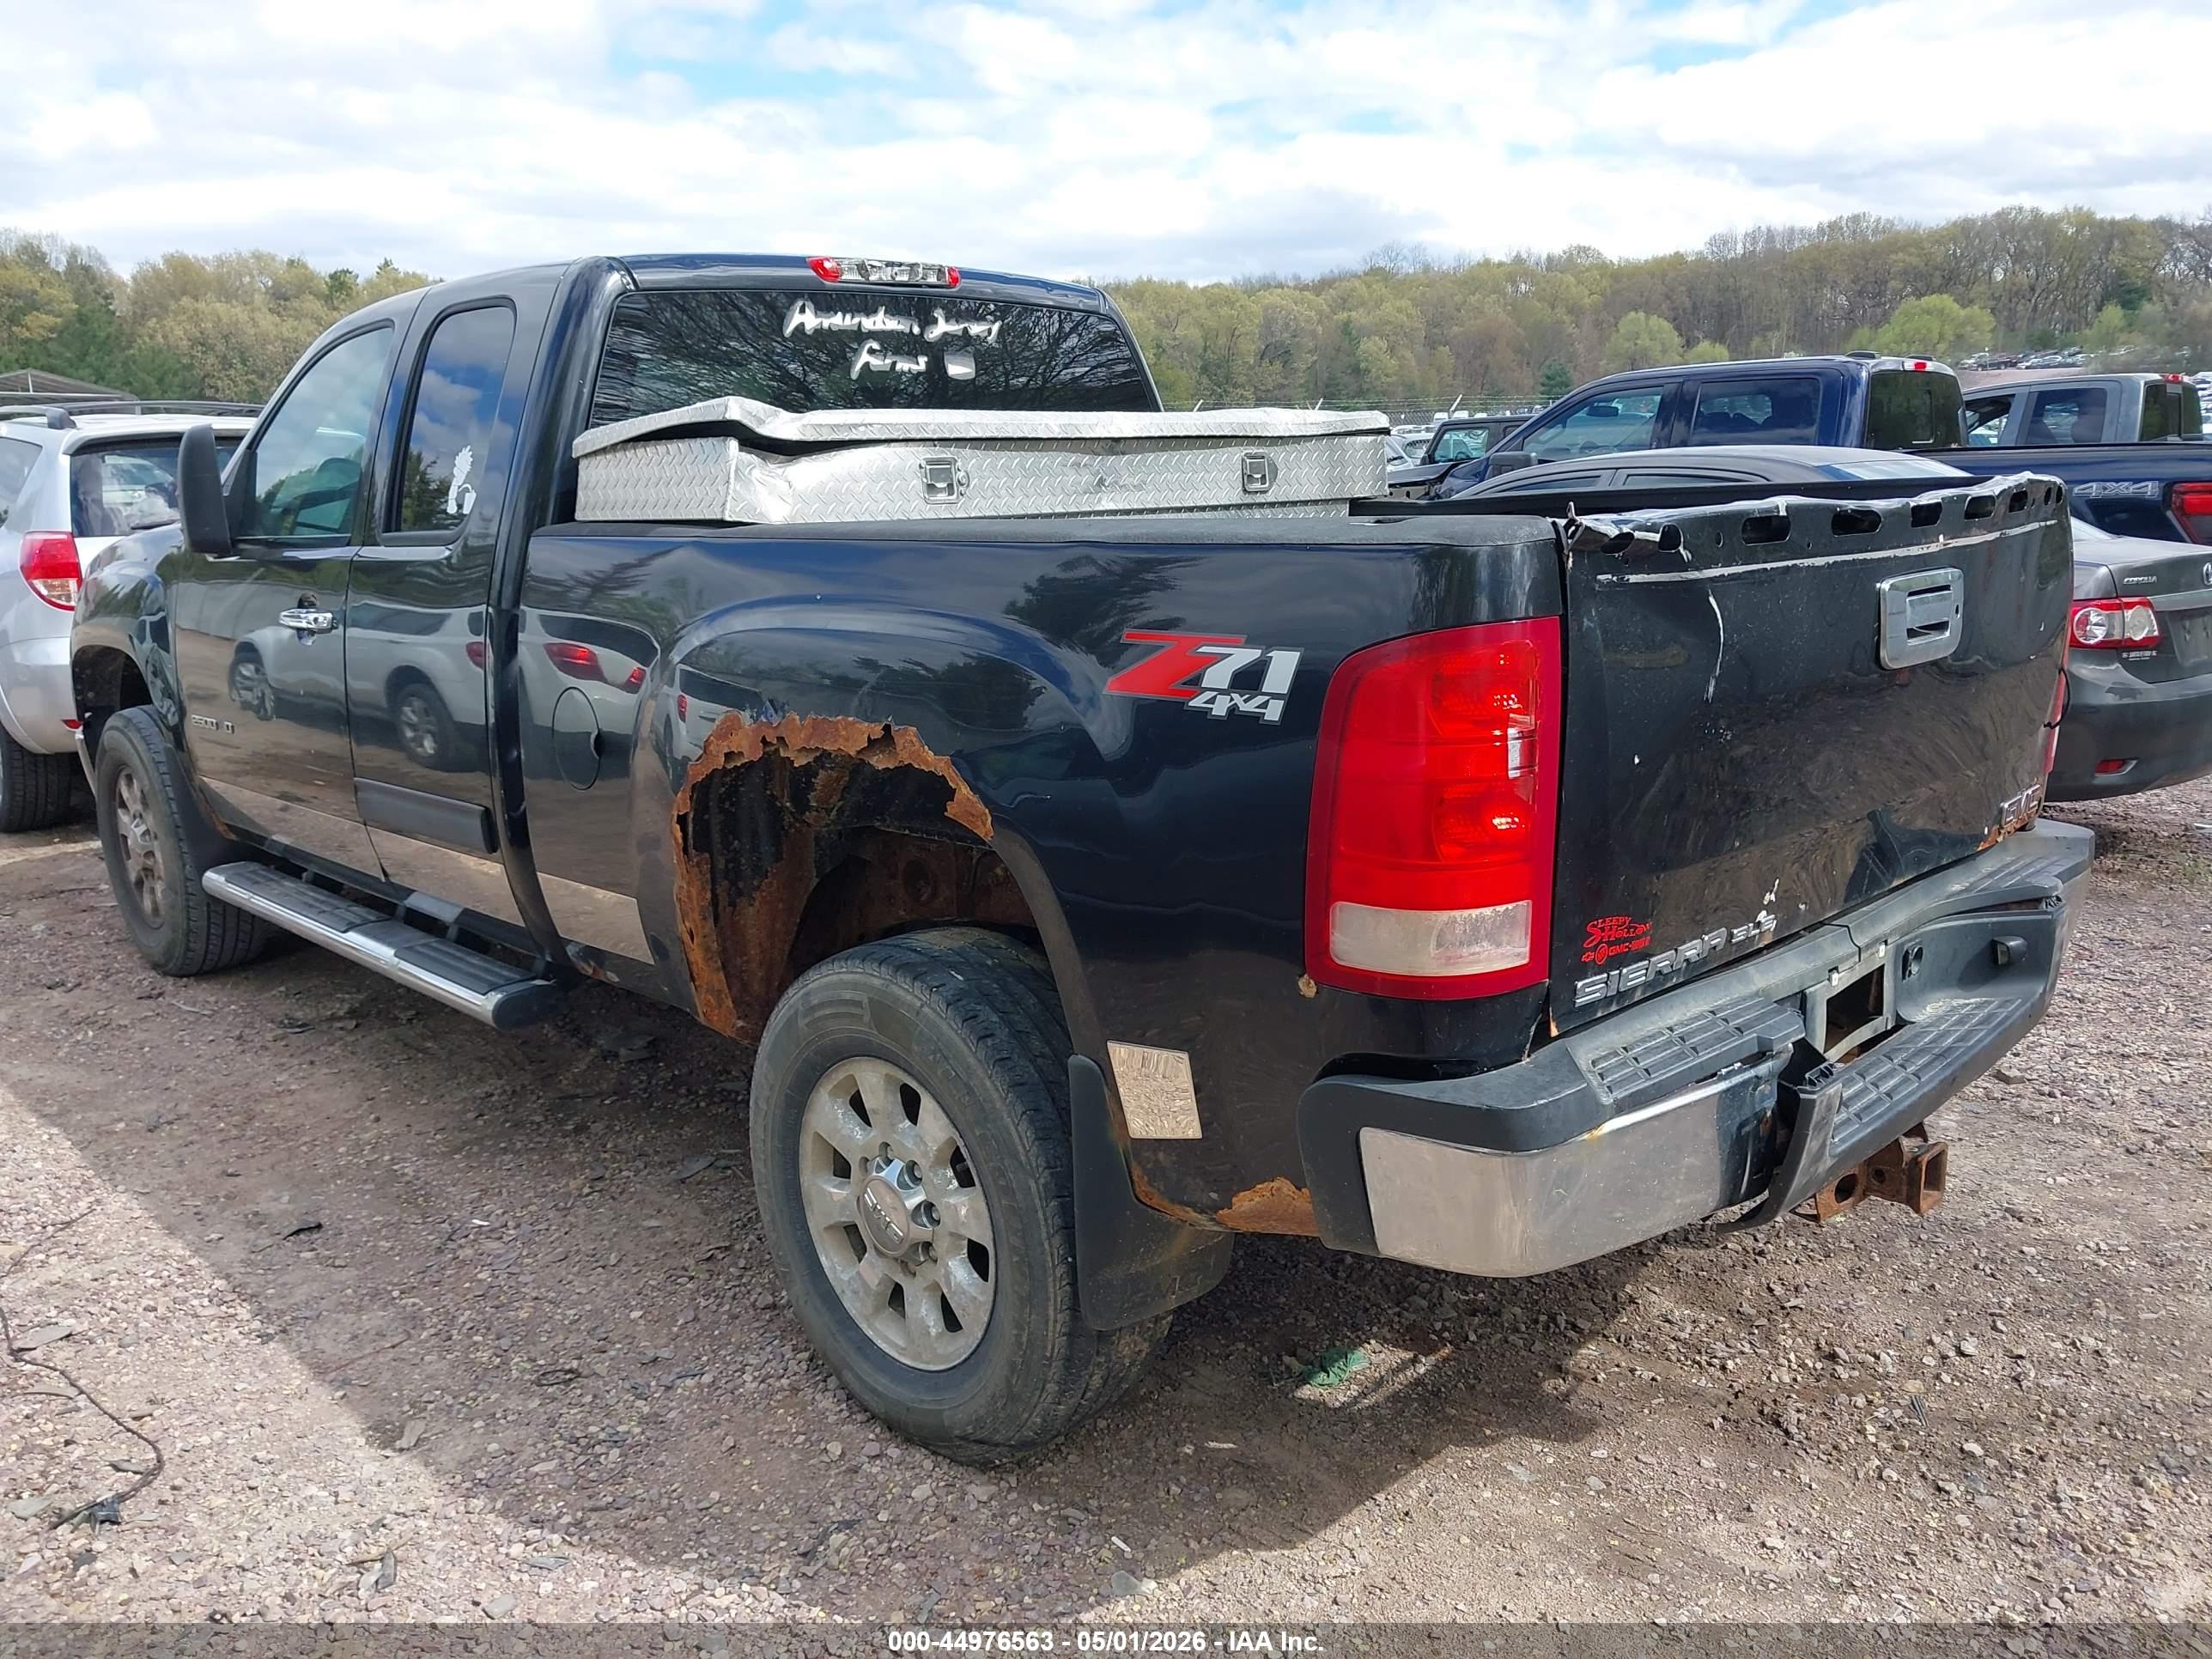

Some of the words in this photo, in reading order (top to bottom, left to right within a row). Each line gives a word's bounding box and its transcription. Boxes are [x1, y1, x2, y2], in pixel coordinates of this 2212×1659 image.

[2124, 575, 2157, 585] COROLLA
[1103, 629, 1304, 699] Z71
[2000, 783, 2041, 828] GMC
[1583, 916, 1632, 947] SLEEPY
[1575, 927, 1727, 1007] SIERRA
